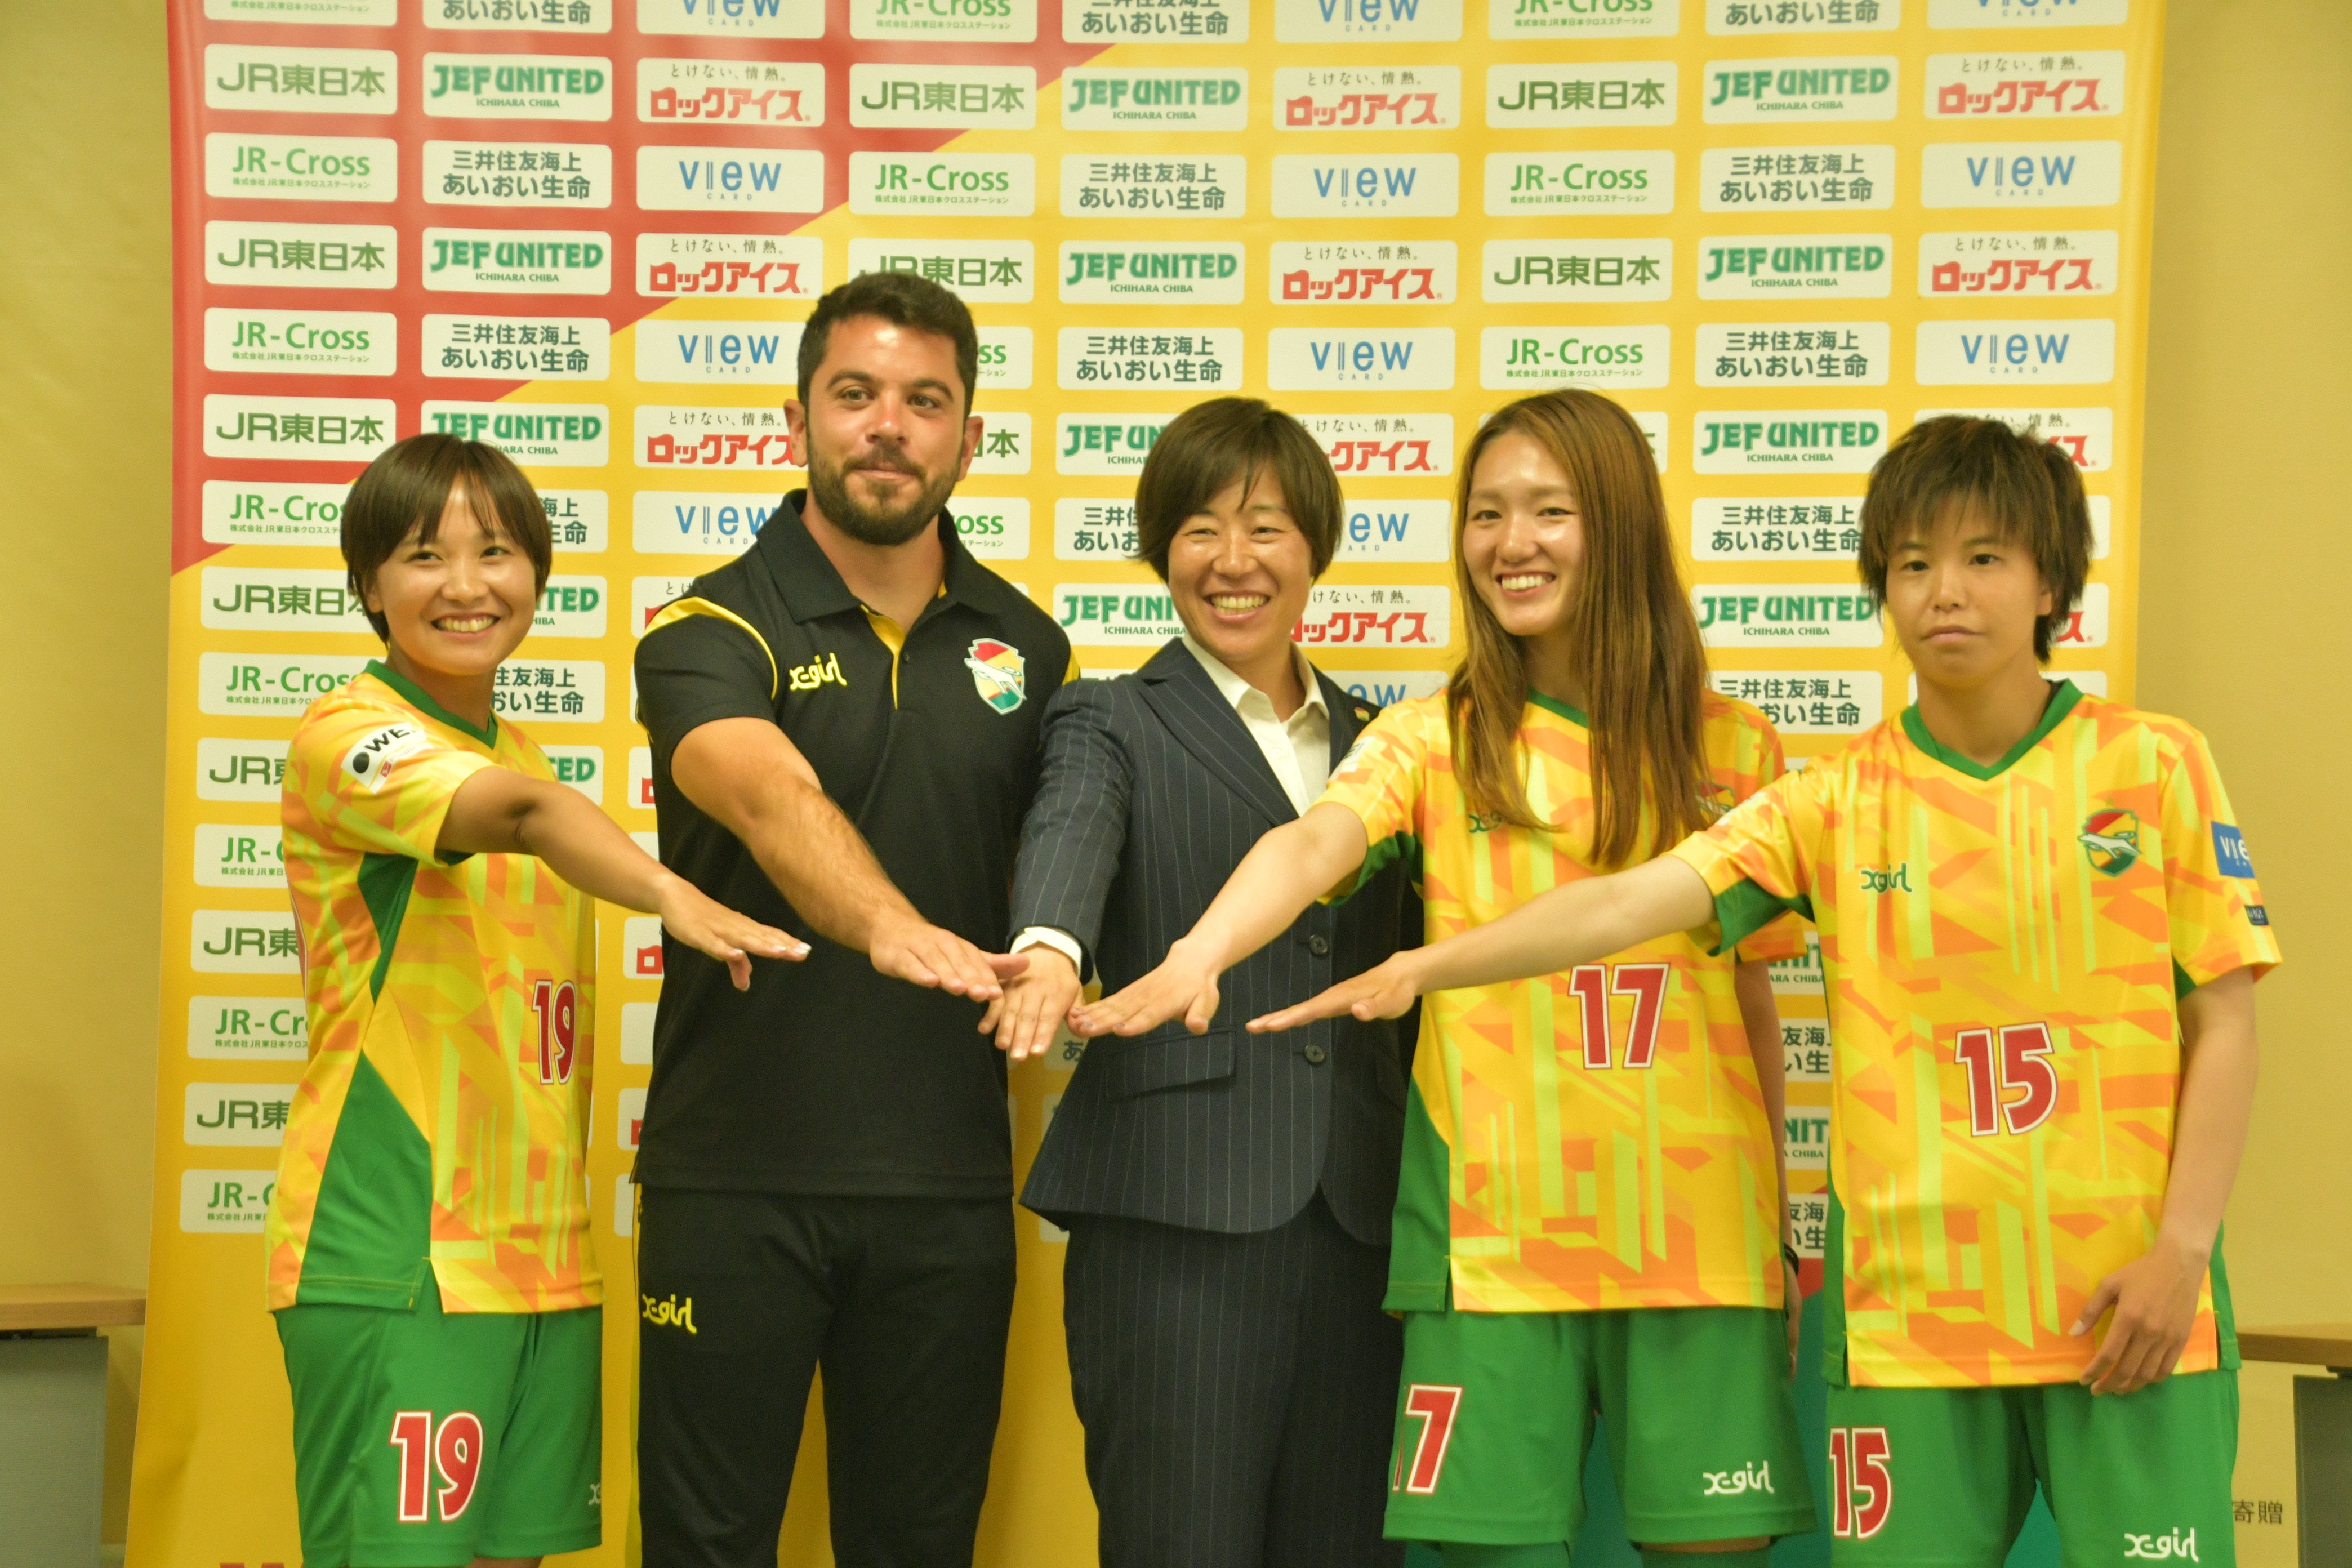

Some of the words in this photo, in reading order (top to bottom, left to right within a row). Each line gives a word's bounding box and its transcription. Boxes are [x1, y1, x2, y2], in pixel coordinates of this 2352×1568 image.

[443, 0, 591, 24] あいおい生命
[1082, 11, 1229, 35] あいおい生命
[1725, 0, 1879, 26] あいおい生命
[217, 63, 385, 97] JR東日本
[431, 65, 491, 98] JEF
[495, 67, 604, 94] UNITED
[1711, 70, 1773, 106] JEF
[1776, 68, 1890, 96] UNITED
[476, 98, 526, 107] ICHIHARA
[528, 99, 560, 108] CHIBA
[861, 81, 1024, 113] JR東日本
[1069, 79, 1129, 112] JEF
[1133, 79, 1241, 105] UNITED
[1498, 79, 1664, 110] JR東日本
[1756, 102, 1808, 112] ICHIHARA
[1811, 101, 1844, 110] CHIBA
[1113, 111, 1162, 120] ICHIHARA
[1165, 111, 1197, 120] CHIBA
[233, 146, 370, 176] JR-Cross
[453, 150, 581, 173] 三井住友海上
[1089, 163, 1217, 183] 三井住友海上
[1731, 154, 1864, 176] 三井住友海上
[443, 173, 590, 199] あいおい生命
[875, 164, 1009, 191] JR-Cross
[1511, 163, 1647, 191] JR-Cross
[706, 192, 752, 201] CARD
[1079, 186, 1226, 210] あいおい生命
[1341, 199, 1387, 207] CARD
[1720, 178, 1873, 203] あいおい生命
[1995, 186, 2044, 197] CARD
[218, 239, 384, 271] JR東日本
[430, 240, 491, 272] JEF
[495, 242, 603, 268] UNITED
[1706, 248, 1767, 282] JEF
[1771, 246, 1885, 273] UNITED
[475, 272, 526, 282] ICHIHARA
[528, 273, 560, 282] CHIBA
[1066, 253, 1125, 285] JEF
[1130, 253, 1237, 278] UNITED
[1494, 256, 1660, 286] JR東日本
[1110, 284, 1160, 293] ICHIHARA
[1162, 284, 1193, 293] CHIBA
[1750, 278, 1803, 288] ICHIHARA
[1805, 278, 1838, 287] CHIBA
[232, 322, 369, 350] JR-Cross
[452, 324, 580, 345] 三井住友海上
[1086, 336, 1214, 355] 三井住友海上
[1726, 330, 1859, 351] 三井住友海上
[442, 347, 589, 373] あいおい生命
[1507, 338, 1643, 364] JR-Cross
[705, 366, 751, 374] CARD
[1077, 359, 1222, 382] あいおい生命
[1338, 371, 1384, 381] CARD
[1716, 354, 1868, 378] あいおい生命
[1990, 366, 2039, 374] CARD
[216, 412, 384, 444] JR東日本
[493, 414, 602, 441] UNITED
[1701, 423, 1763, 456] JEF
[1767, 422, 1879, 448] UNITED
[527, 446, 558, 455] CHIBA
[1063, 425, 1122, 457] JEF
[1747, 453, 1798, 462] ICHIHARA
[1801, 453, 1834, 462] CHIBA
[230, 494, 345, 522] JR-Cro
[1722, 504, 1855, 525] 三井住友海上
[1313, 590, 1410, 604] けない、情熱。
[1061, 595, 1119, 627] JEF
[1123, 595, 1173, 621] UNI
[1698, 596, 1759, 627] JEF
[1763, 595, 1876, 622] UNITED
[1743, 627, 1795, 636] ICHIHARA
[1797, 627, 1830, 636] CHIBA
[1719, 678, 1851, 698] 三井住友海上
[203, 927, 300, 957] JR東
[215, 1009, 308, 1035] JR-Cr
[1567, 963, 1671, 1070] 17
[532, 979, 577, 1085] 19
[1954, 1021, 2059, 1138] 15
[197, 1100, 290, 1129] JR東
[1792, 1150, 1824, 1158] CHIBA
[389, 1410, 484, 1523] 19
[1829, 1427, 1892, 1539] 15
